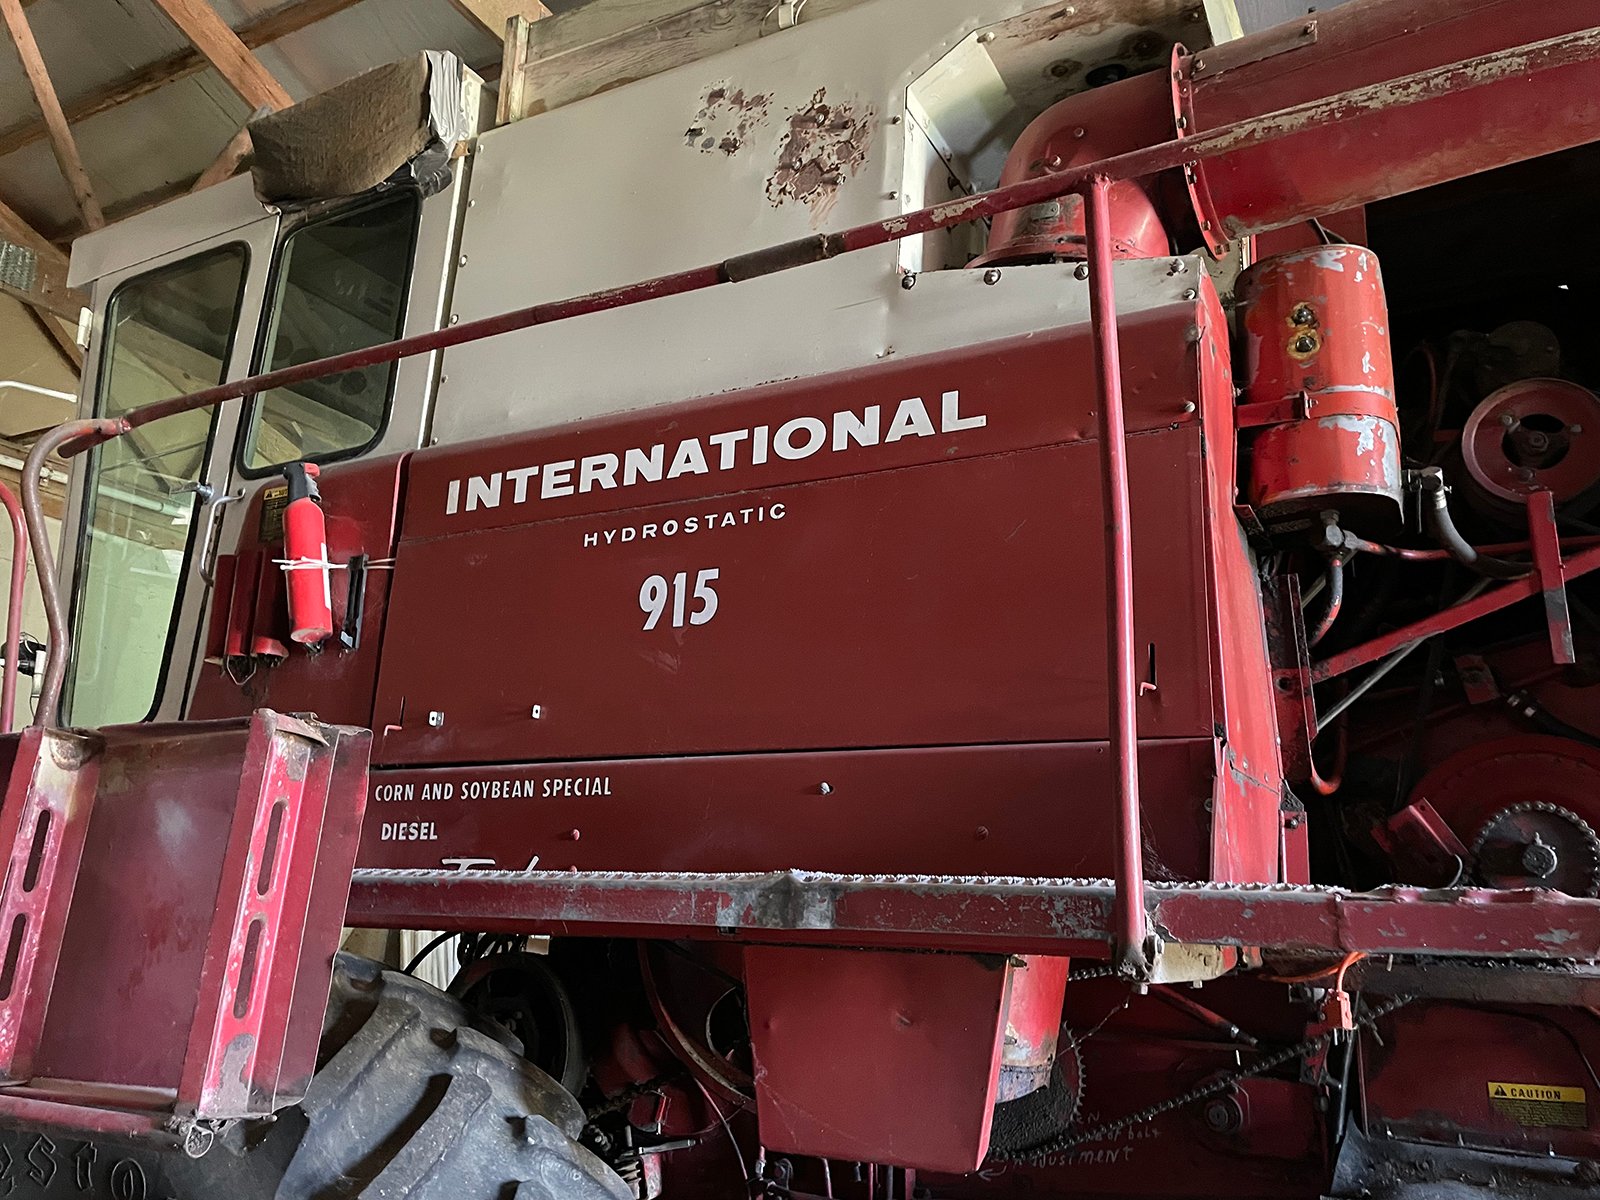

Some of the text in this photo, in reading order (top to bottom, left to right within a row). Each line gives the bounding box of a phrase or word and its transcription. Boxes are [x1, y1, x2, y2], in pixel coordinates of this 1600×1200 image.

[445, 390, 987, 515] INTERNATIONAL
[582, 503, 788, 548] HYDROSTATIC
[638, 568, 720, 632] 915
[374, 777, 612, 802] CORN AND SOYBEAN SPECIAL
[380, 822, 438, 841] DIESEL
[1510, 1088, 1561, 1100] CAUTION
